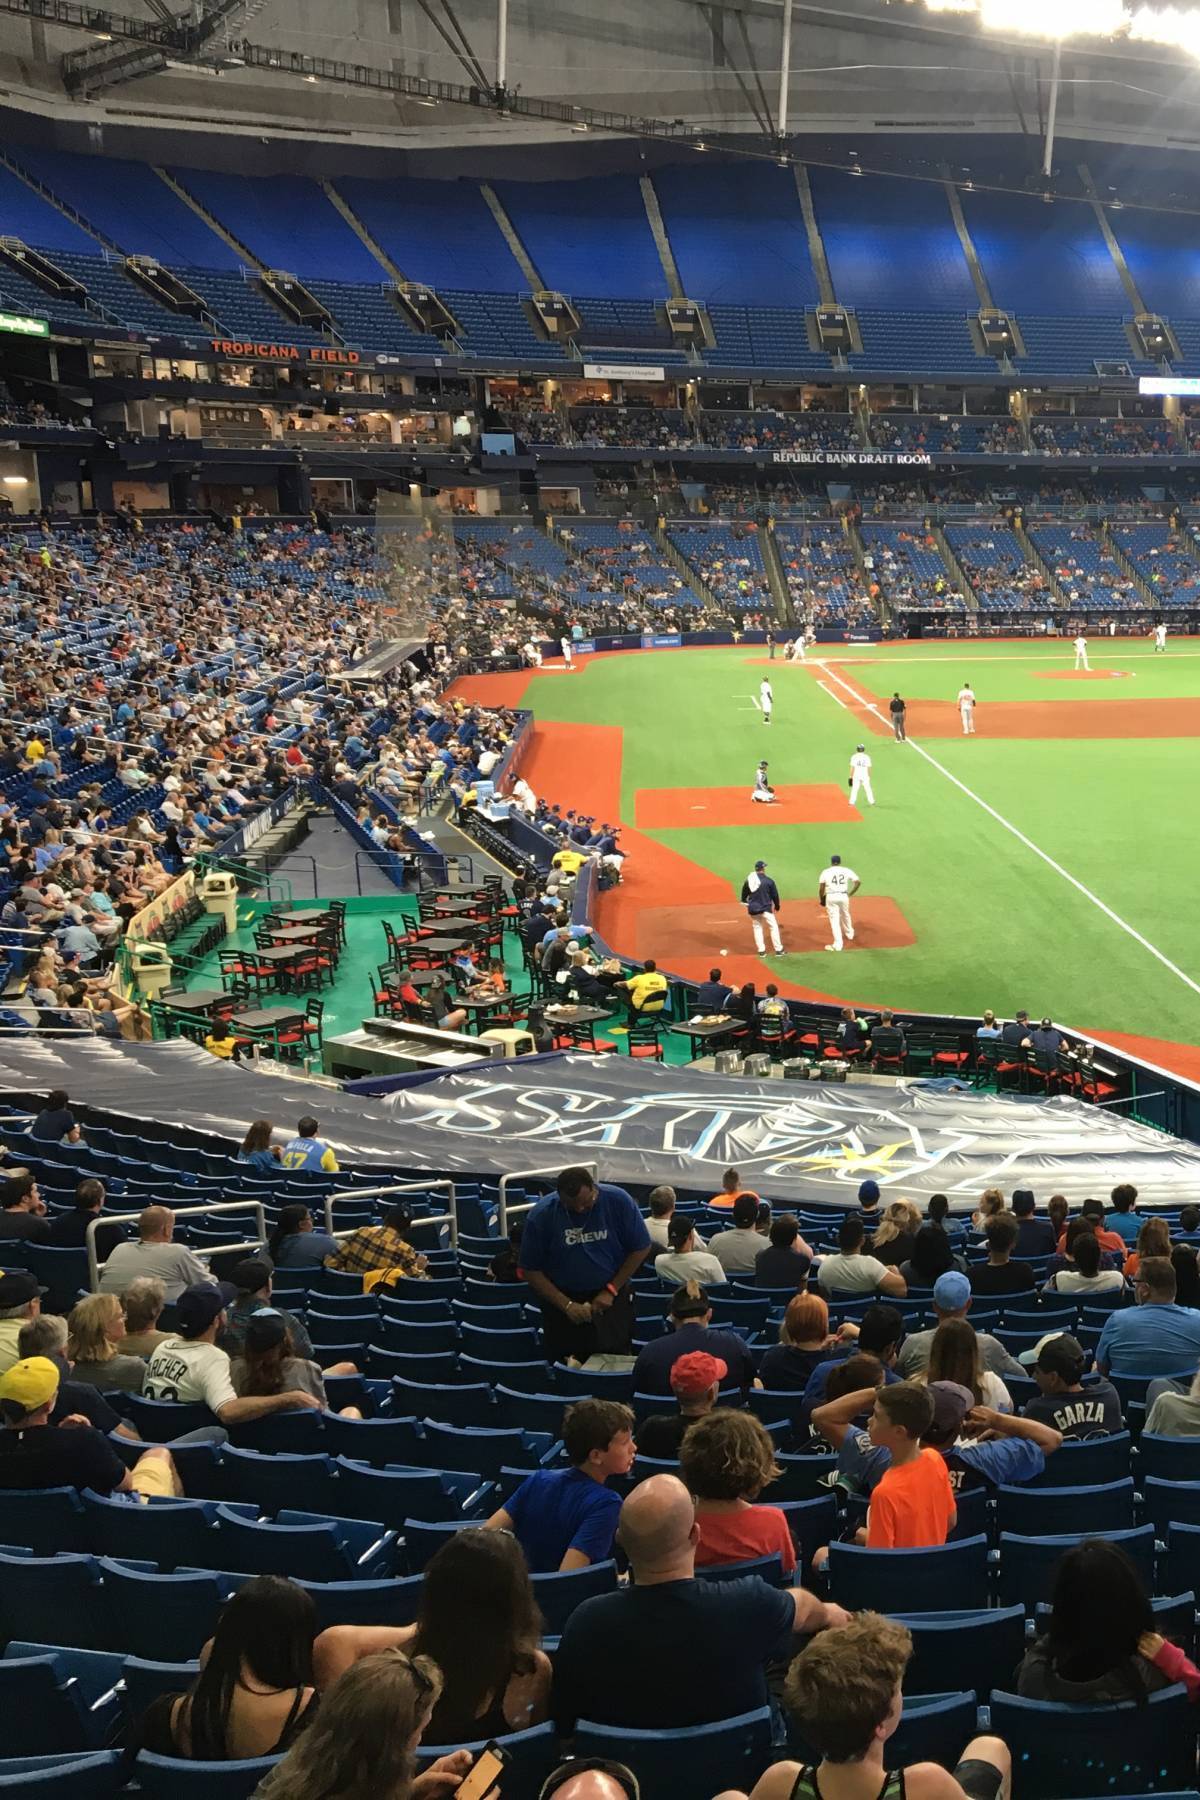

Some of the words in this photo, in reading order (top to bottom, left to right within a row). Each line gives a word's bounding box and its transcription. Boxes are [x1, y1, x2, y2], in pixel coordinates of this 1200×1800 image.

[211, 340, 300, 359] TROPICANA
[310, 349, 360, 363] FIELD
[772, 452, 824, 463] REPUBLIC
[826, 453, 856, 463] BANK
[859, 454, 894, 464] DRAFT
[896, 455, 931, 464] ROOM
[831, 874, 845, 886] 42
[565, 1230, 608, 1246] CREW
[1053, 1401, 1105, 1430] GARZA
